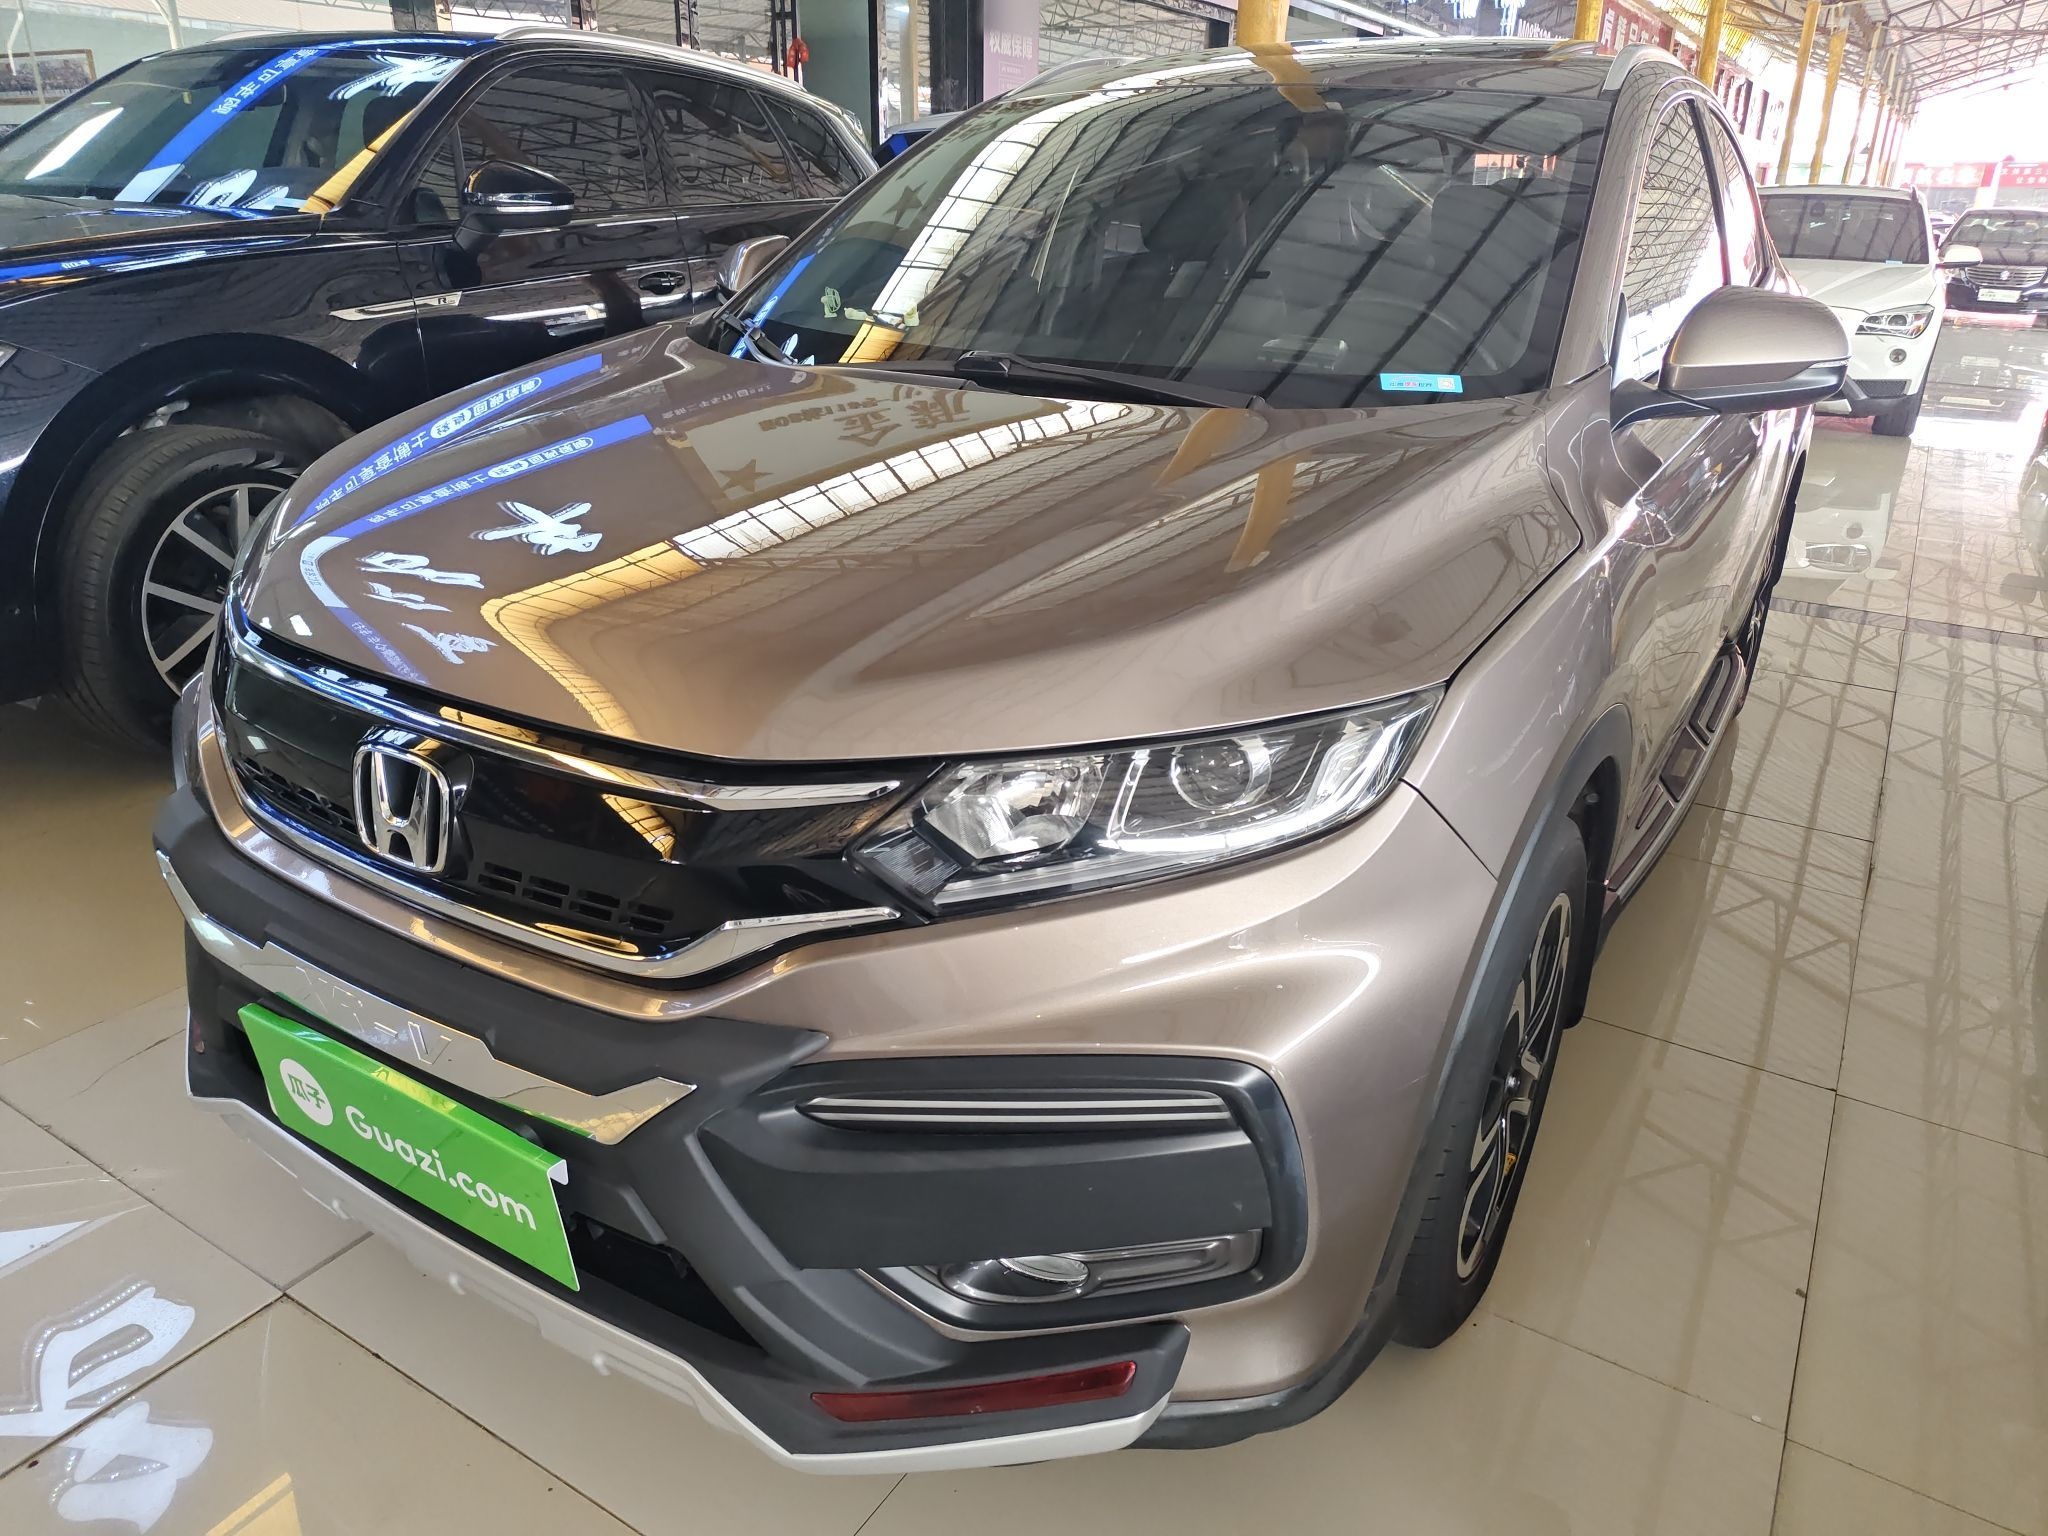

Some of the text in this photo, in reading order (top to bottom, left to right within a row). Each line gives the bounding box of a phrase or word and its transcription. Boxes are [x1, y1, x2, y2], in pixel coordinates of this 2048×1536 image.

[989, 31, 1033, 60] 权威保障
[284, 1070, 329, 1111] 瓜子
[343, 1105, 539, 1231] Guazi.com
